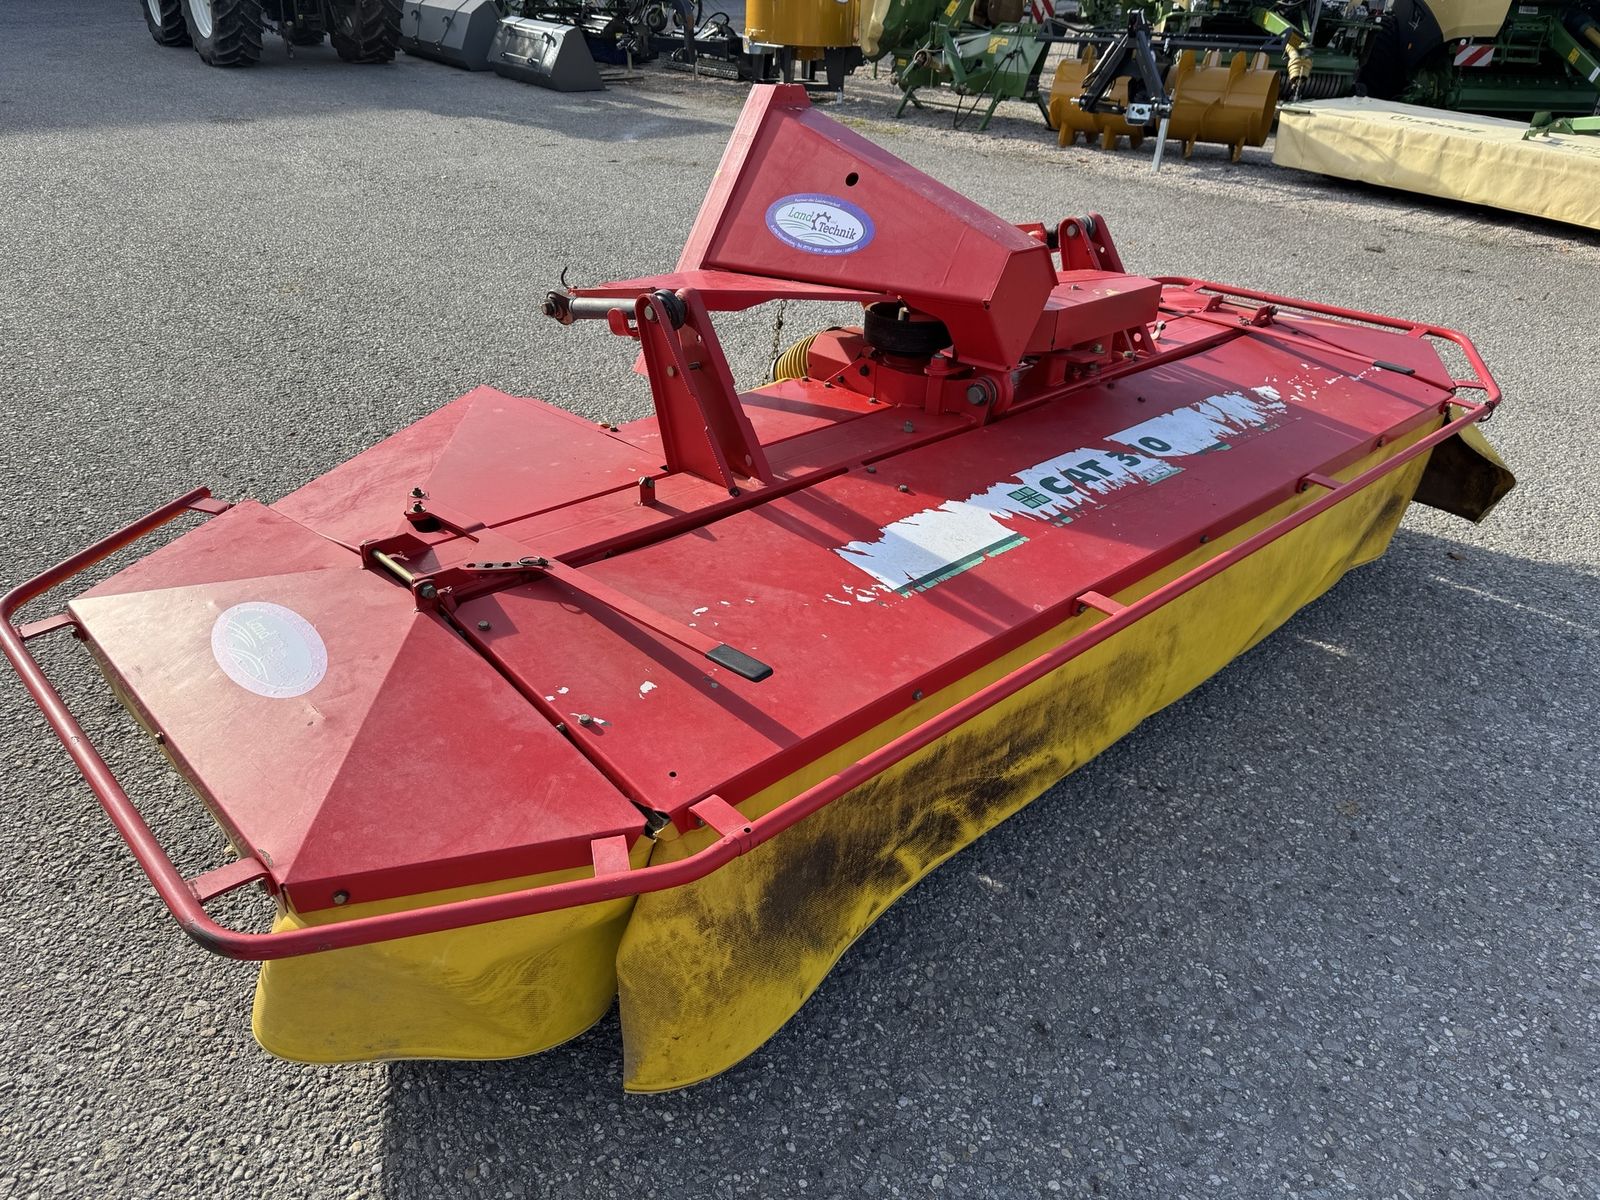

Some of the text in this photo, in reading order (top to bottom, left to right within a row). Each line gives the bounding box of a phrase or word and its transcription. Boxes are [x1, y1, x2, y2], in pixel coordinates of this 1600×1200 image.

[788, 207, 815, 222] Land
[818, 221, 857, 240] Technik
[1039, 459, 1114, 495] CAT
[1105, 436, 1173, 467] 310
